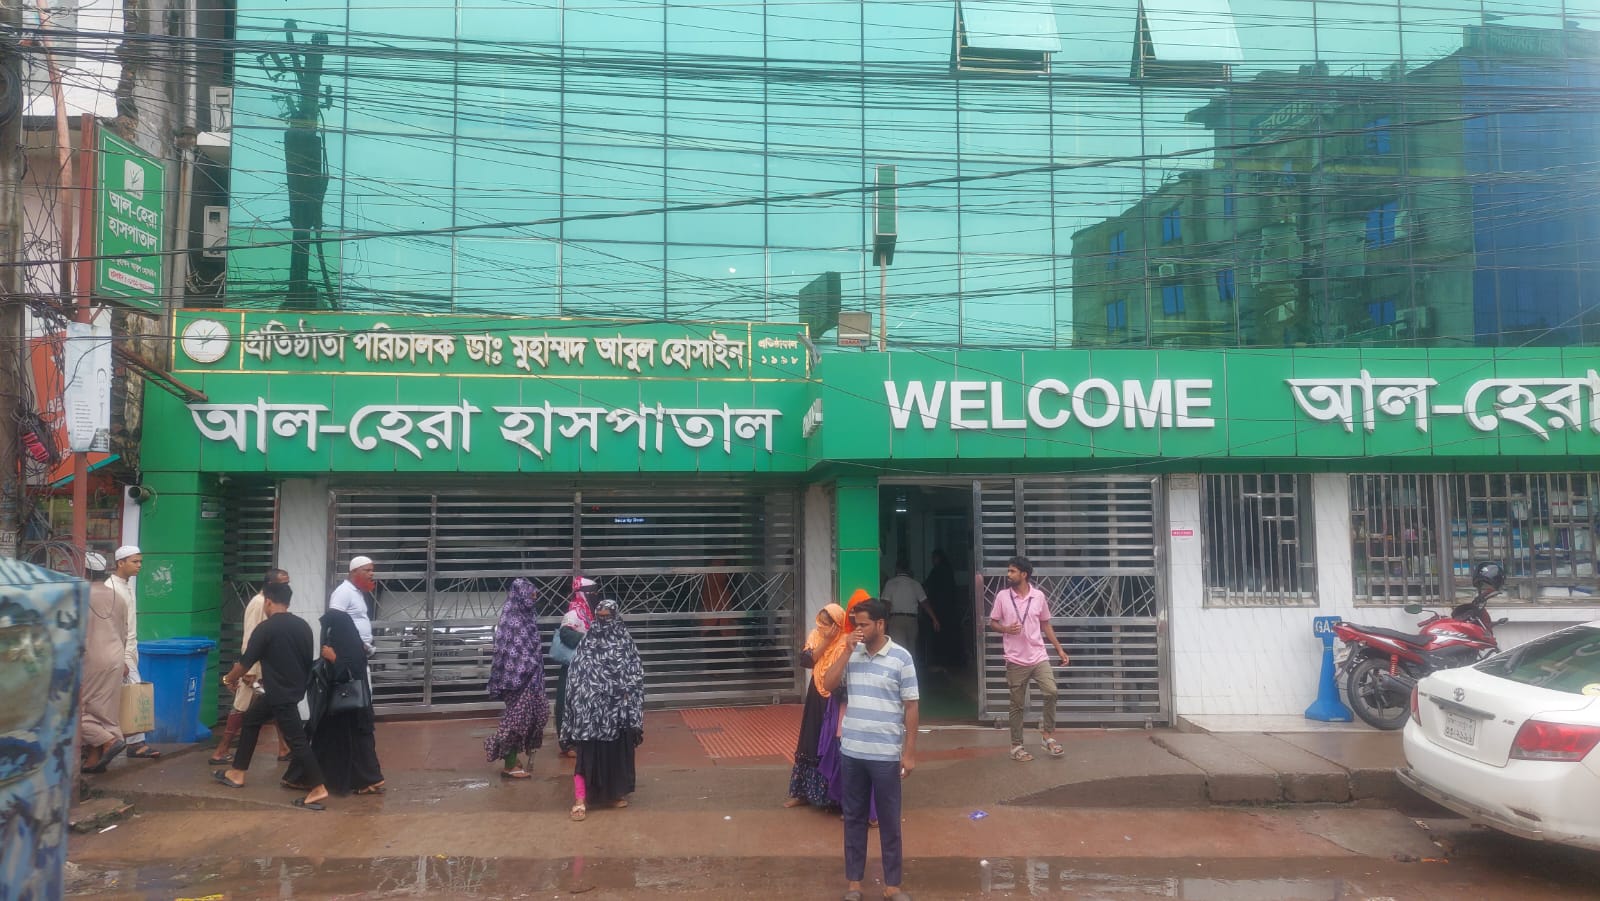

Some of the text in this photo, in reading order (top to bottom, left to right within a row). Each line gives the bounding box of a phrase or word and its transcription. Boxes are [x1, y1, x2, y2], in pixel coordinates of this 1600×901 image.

[108, 190, 158, 229] আল-হেরা
[108, 215, 158, 253] হাসপাতাল
[244, 318, 349, 363] প্রতিষ্ঠাতা
[352, 322, 456, 365] পরিচালক
[509, 331, 589, 372] মুহাম্মদ
[593, 331, 658, 373] আবুল
[661, 329, 747, 370] হোসাইন
[186, 396, 783, 461] আল-হেরা হাসপাতাল
[884, 378, 1216, 430] WELCOME
[1284, 368, 1600, 441] আল-হেরা
